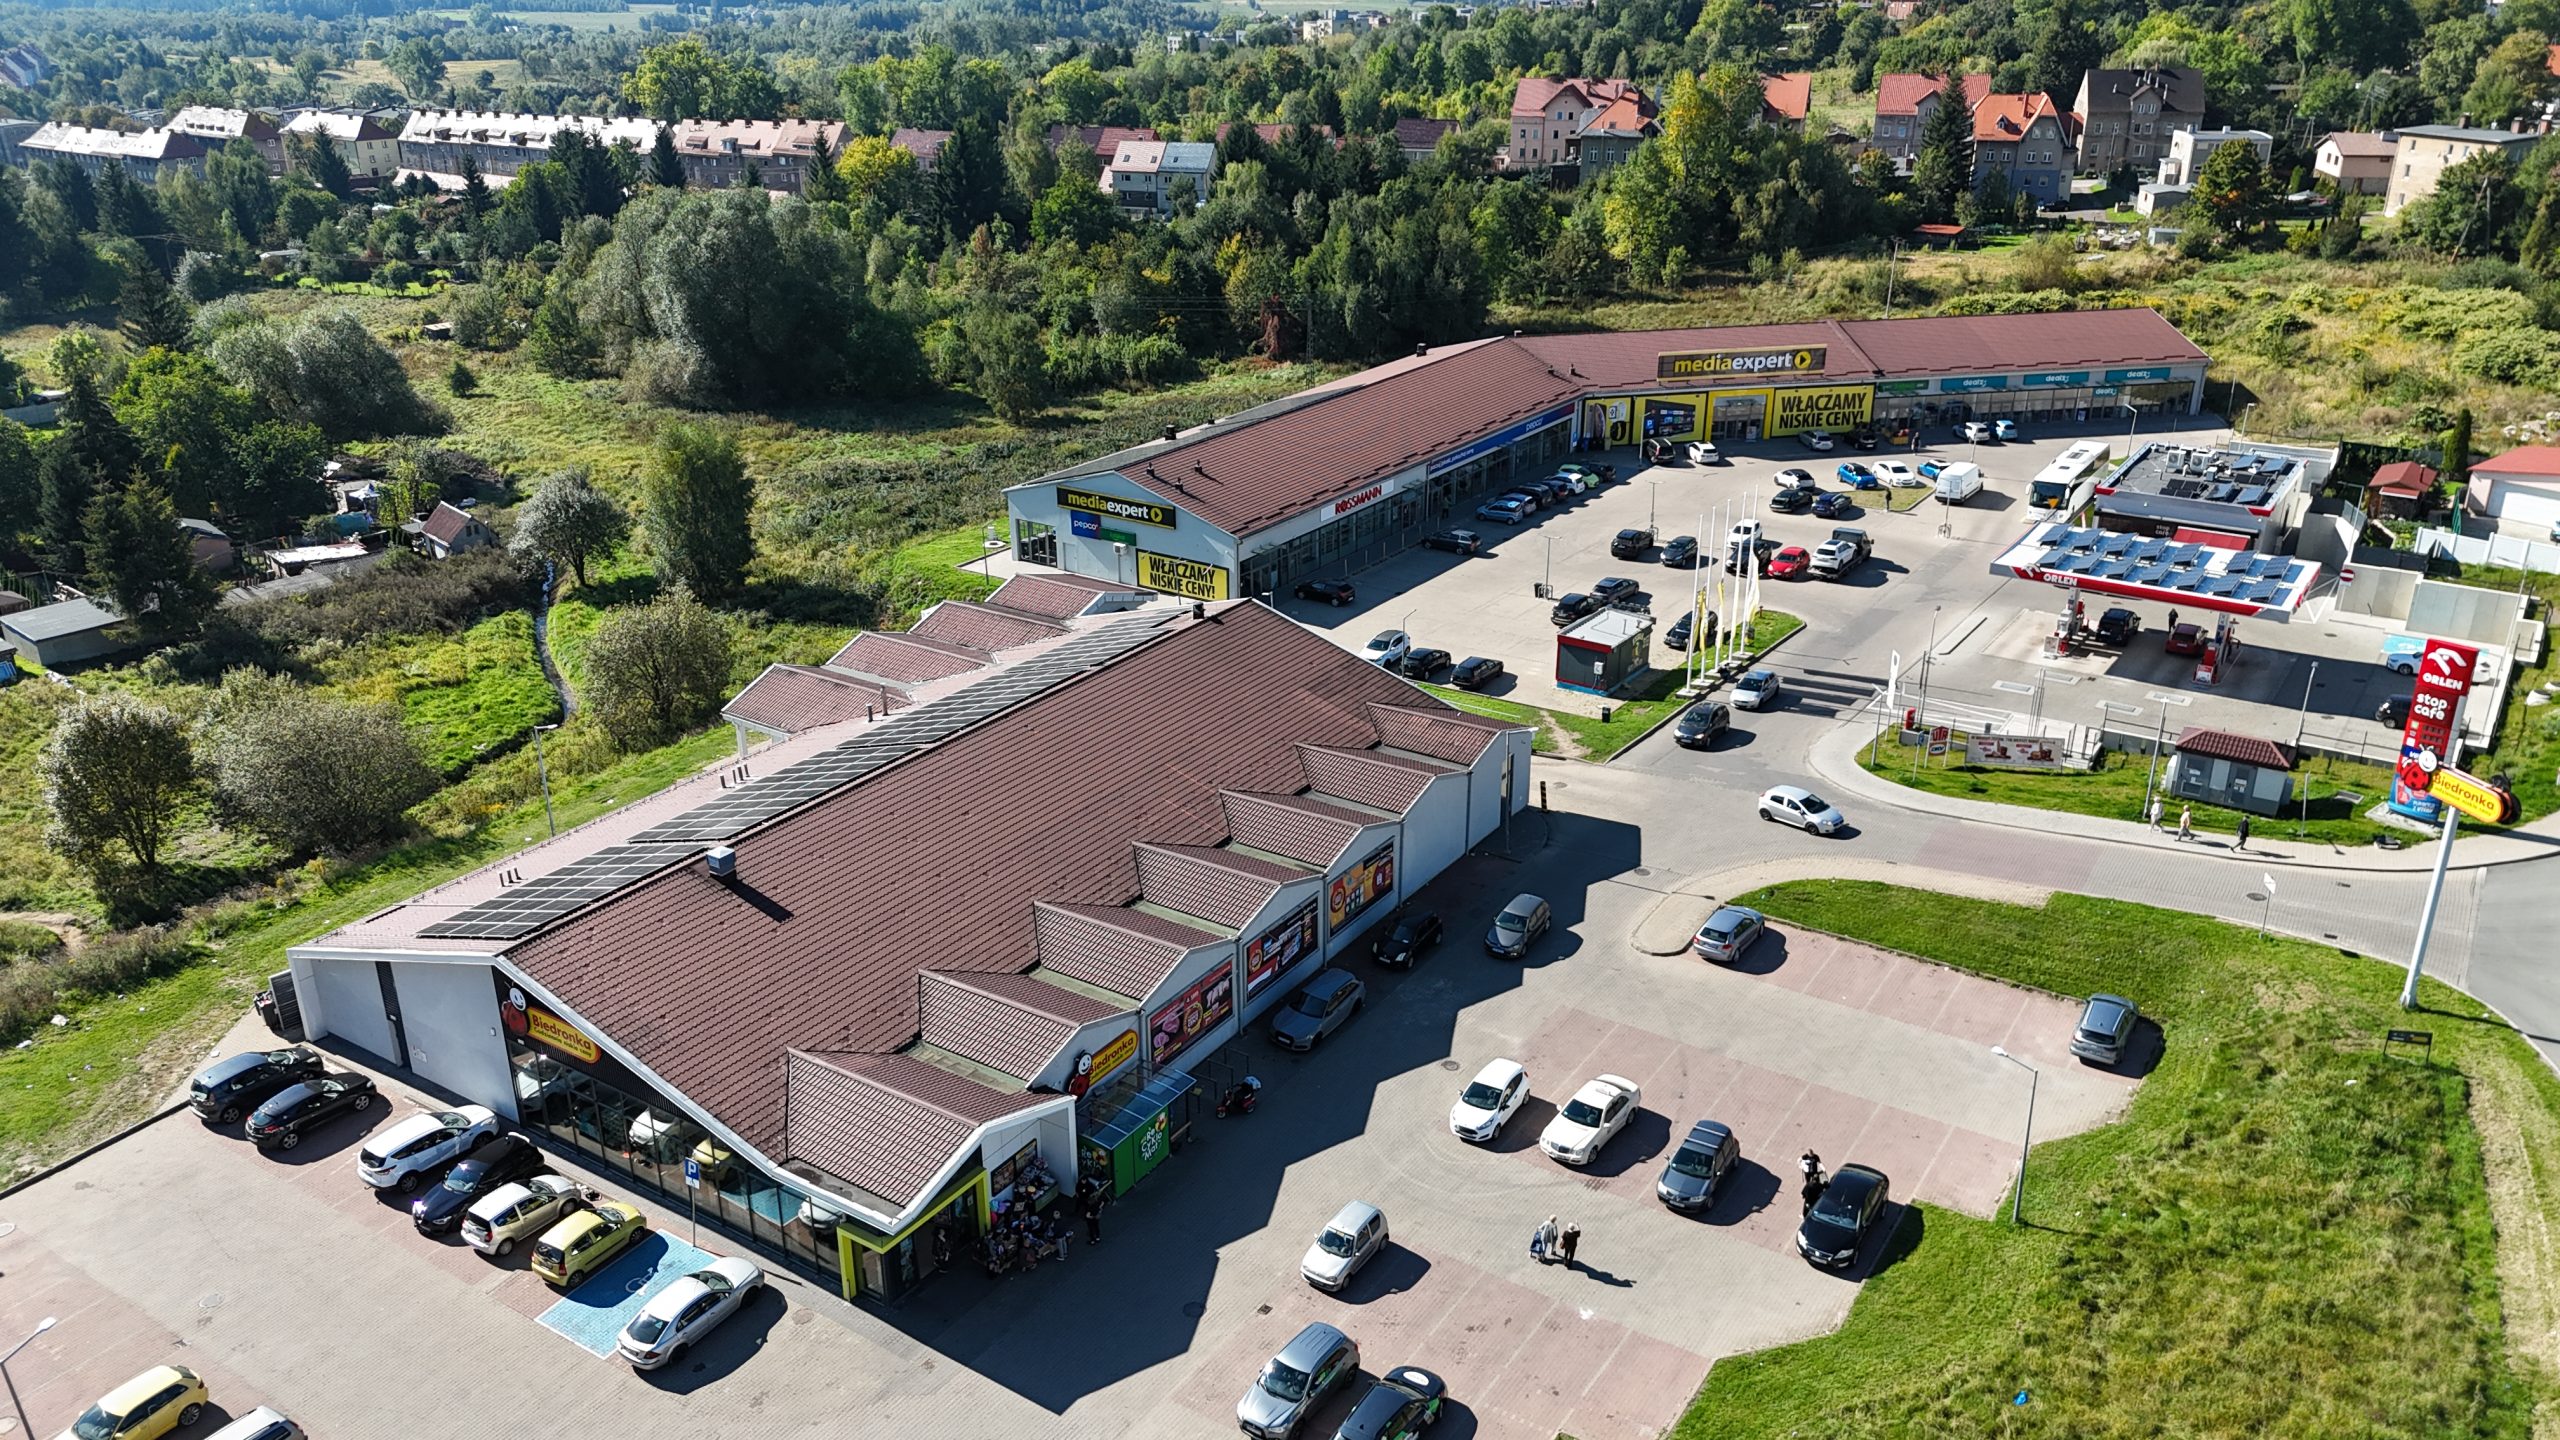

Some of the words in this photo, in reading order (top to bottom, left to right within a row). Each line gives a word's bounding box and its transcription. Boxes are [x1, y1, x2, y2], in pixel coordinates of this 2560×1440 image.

[1674, 352, 1793, 373] mediaexpert
[1781, 392, 1866, 413] WŁĄCZAMY
[1779, 412, 1823, 429] NISKIE
[1826, 410, 1864, 426] CENY!
[1067, 493, 1149, 519] mediaexpert
[1335, 485, 1382, 515] ROSSMANN
[1073, 520, 1098, 531] pepco
[1149, 555, 1216, 584] WŁĄCZAMY
[2043, 573, 2078, 586] ORLEN
[1149, 572, 1183, 592] NISKIE
[1185, 580, 1215, 599] CENY!
[2422, 672, 2463, 690] ORLEN
[2414, 704, 2445, 720] cafe
[2416, 693, 2448, 711] stop
[2432, 771, 2494, 810] Biedronka
[532, 1014, 592, 1050] Biedronka
[688, 1161, 697, 1175] P
